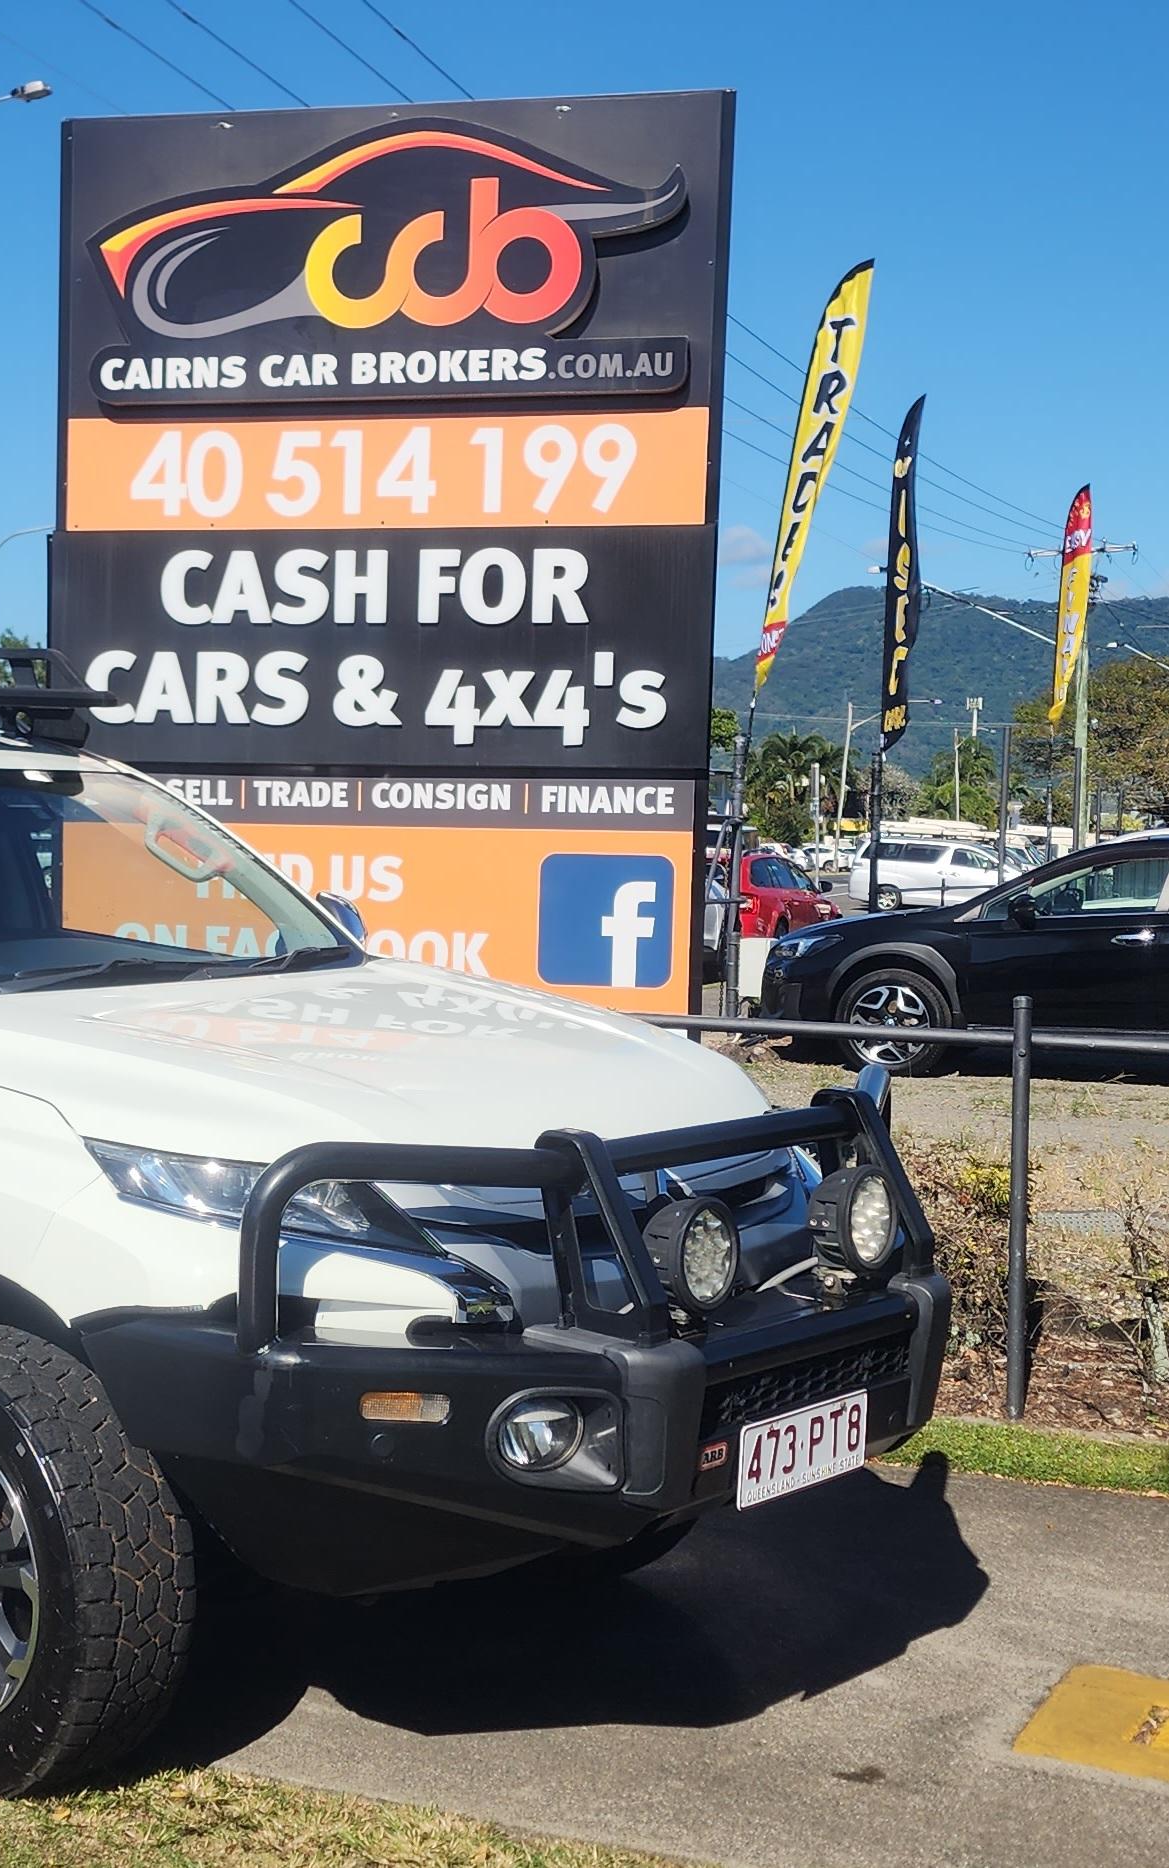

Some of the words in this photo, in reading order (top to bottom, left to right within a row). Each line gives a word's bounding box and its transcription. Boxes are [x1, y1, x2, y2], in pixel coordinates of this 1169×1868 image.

[100, 355, 247, 391] CAIRNS
[258, 353, 339, 388] CAR
[130, 429, 244, 518] 40
[261, 426, 438, 518] 514
[468, 422, 639, 514] 199
[160, 548, 390, 626] CASH
[417, 547, 590, 626] FOR
[85, 649, 310, 726] CARS
[332, 654, 403, 728] &
[168, 779, 234, 807] SELL
[252, 780, 350, 809] TRADE
[370, 781, 512, 812] CONSIGN
[540, 784, 675, 815] FINANCE
[329, 854, 405, 902] US
[702, 1447, 725, 1465] ARB
[746, 1476, 795, 1503] QUEENSLAND
[802, 1461, 837, 1485] SUNSHINE
[839, 1454, 860, 1472] STATE
